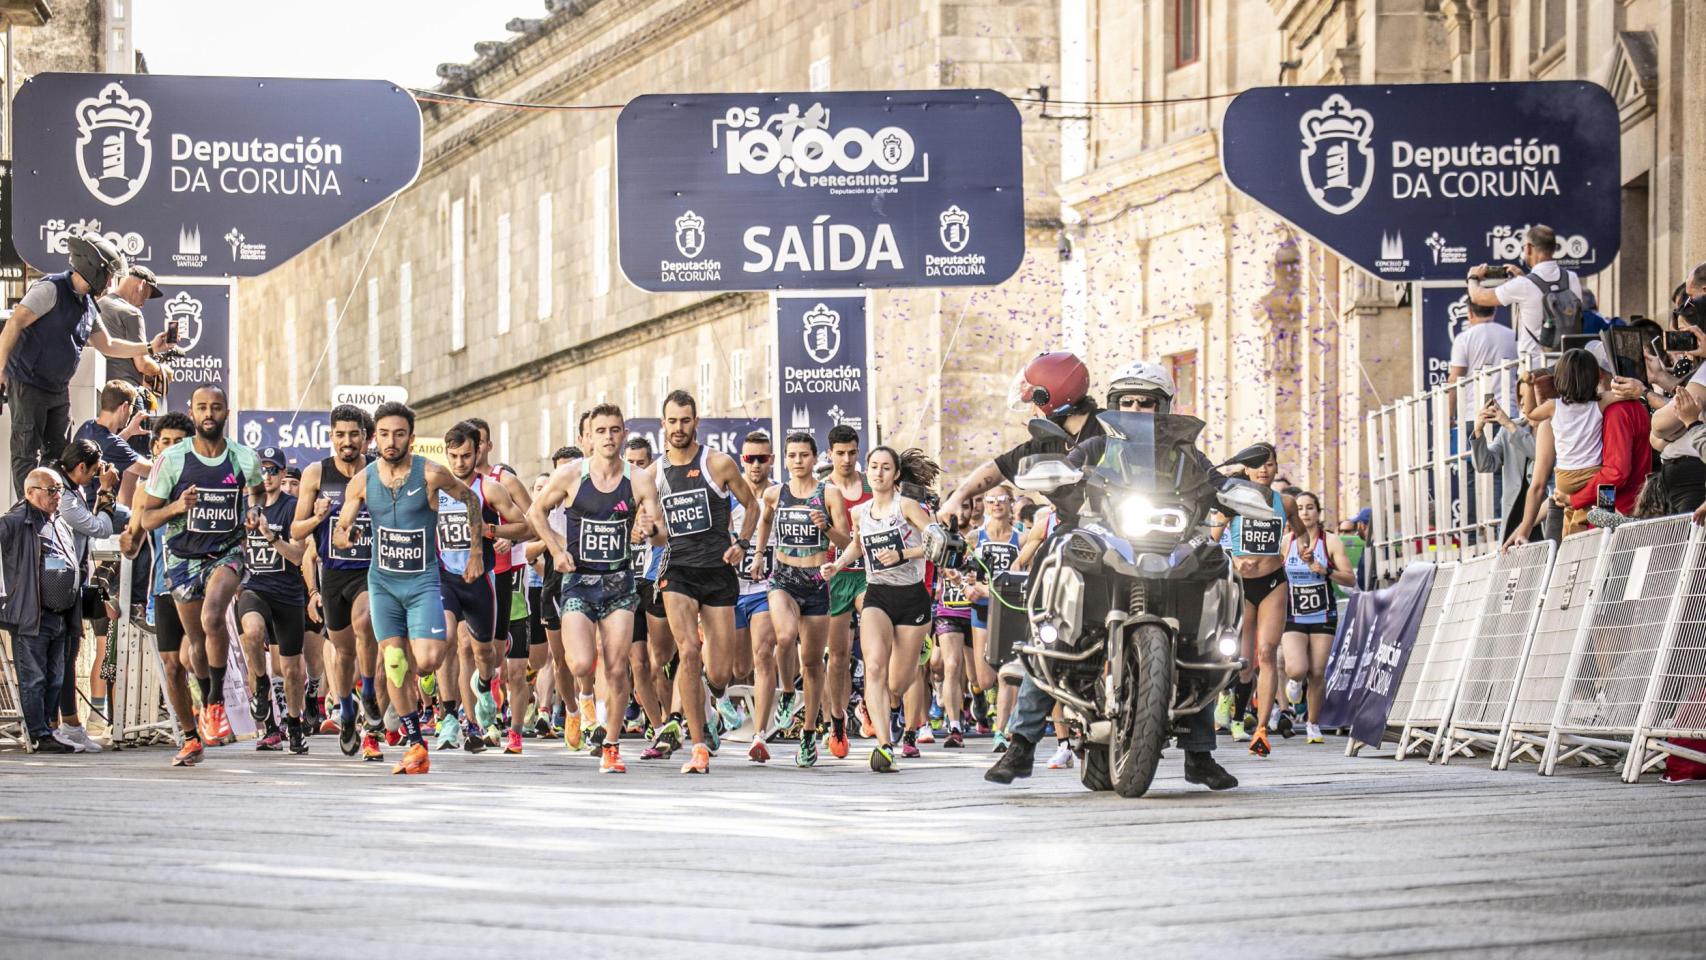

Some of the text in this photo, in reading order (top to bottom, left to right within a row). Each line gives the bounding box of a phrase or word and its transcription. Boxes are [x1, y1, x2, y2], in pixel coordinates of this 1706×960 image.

[171, 133, 342, 169] Deputación
[1392, 139, 1560, 174] Deputación
[171, 164, 341, 195] DA CORUÑA
[1392, 165, 1560, 199] DA CORUÑA
[743, 215, 904, 273] SAÍDA
[661, 259, 721, 273] Deputación
[925, 253, 986, 268] Deputación
[661, 269, 721, 282] DA CORUÑA
[925, 264, 986, 276] DA CORUÑA
[171, 354, 222, 368] utación
[174, 368, 222, 382] ORUÑA
[785, 365, 860, 382] Deputación
[785, 378, 860, 393] DA CORUÑA
[337, 392, 385, 405] CAIXÓN
[279, 421, 332, 449] SAÍD
[706, 432, 738, 453] 5K
[414, 443, 444, 455] AIXÓ
[671, 506, 704, 523] ARCE
[210, 521, 216, 529] 2
[781, 524, 816, 536] IRENE
[586, 535, 620, 550] BEN
[1245, 531, 1275, 543] BREA
[247, 548, 277, 564] 147
[381, 545, 421, 560] CARRO
[1300, 594, 1320, 609] 20
